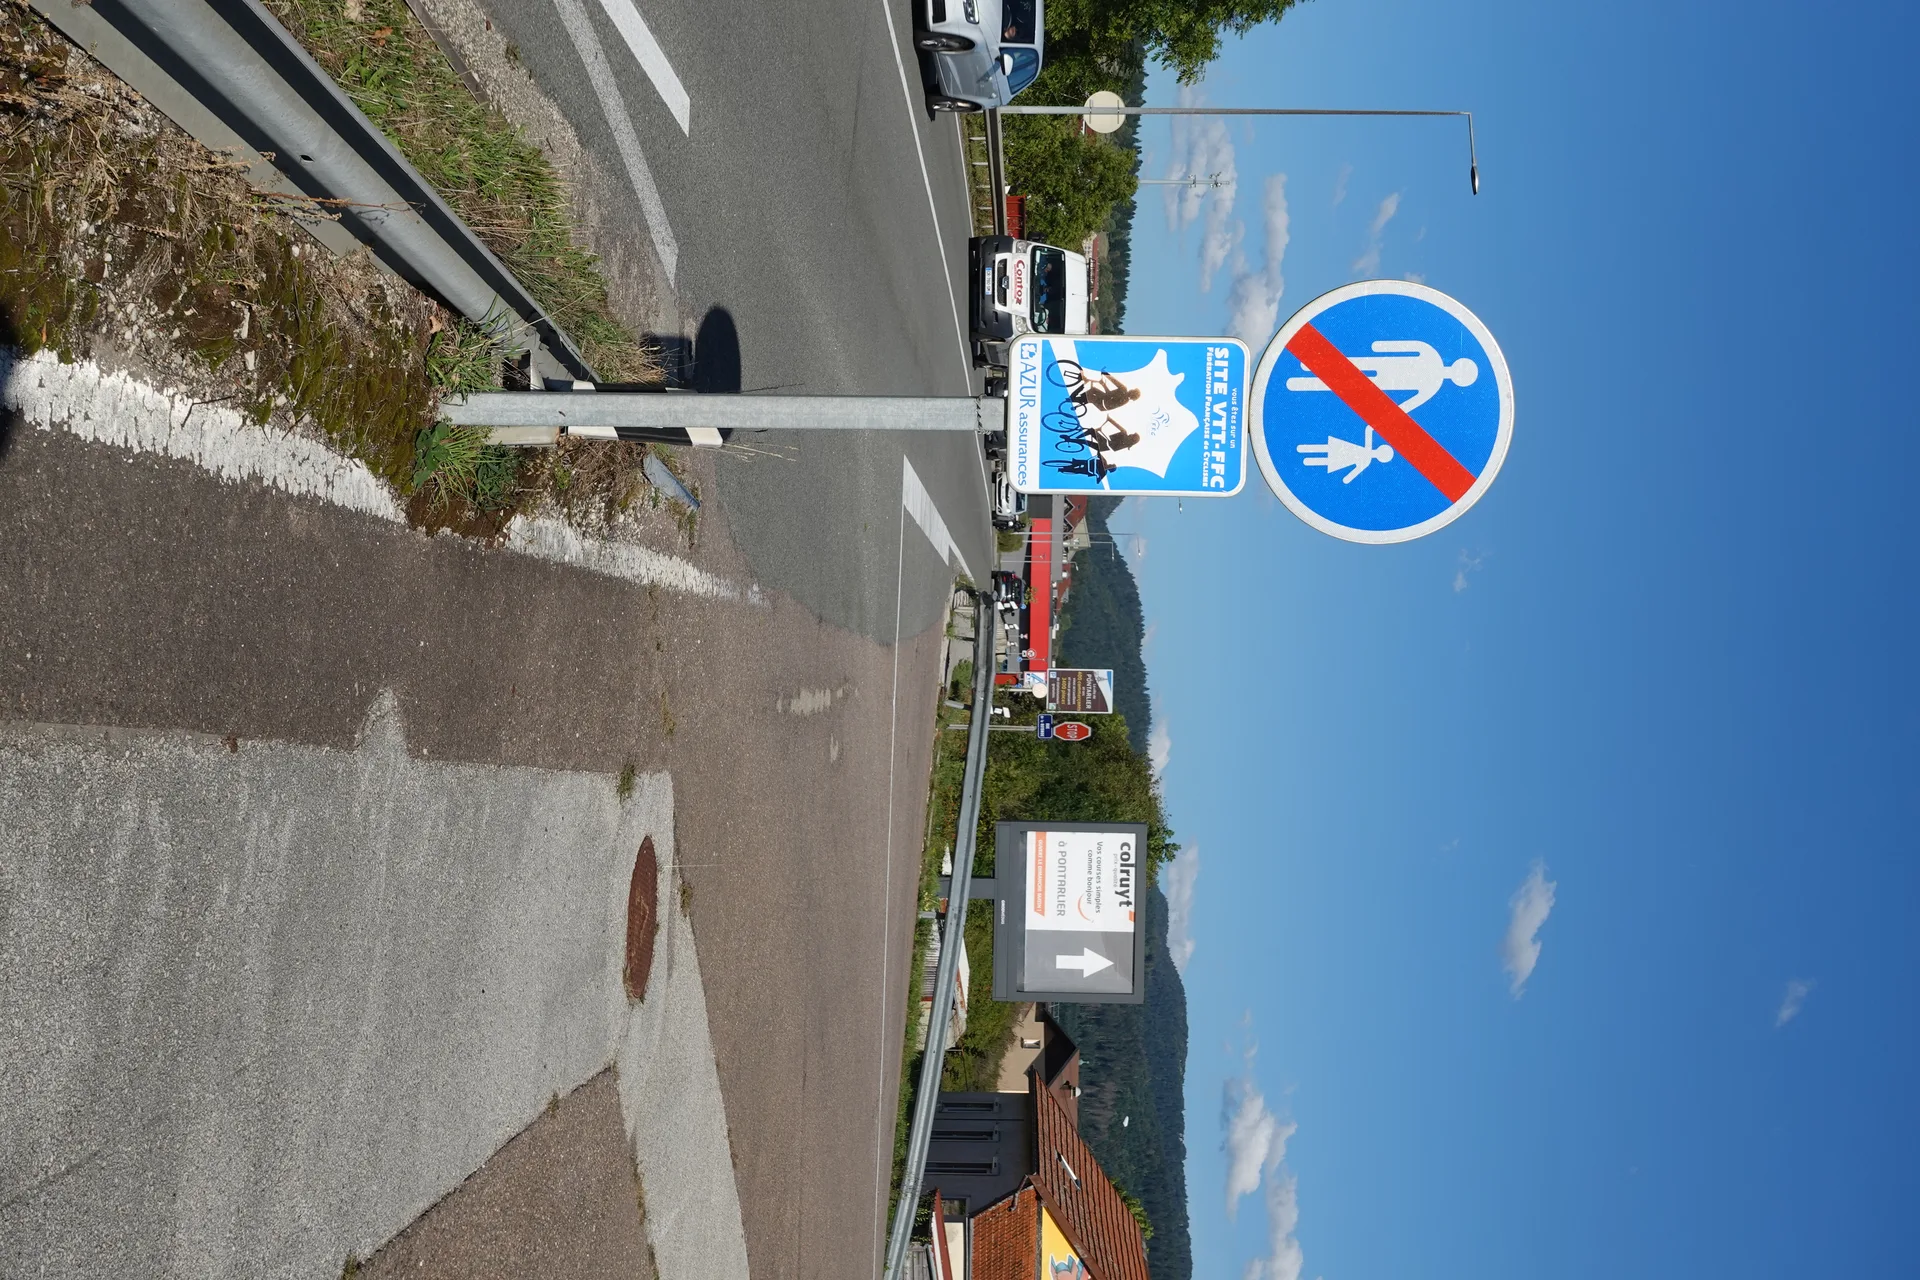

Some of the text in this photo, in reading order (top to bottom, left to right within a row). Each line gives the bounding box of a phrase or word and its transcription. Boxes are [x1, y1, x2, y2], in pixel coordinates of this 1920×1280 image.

[1018, 362, 1036, 486] AZUR assurances
[1203, 441, 1209, 450] de
[1210, 348, 1228, 488] SITE VTT-FFC
[1230, 440, 1235, 448] un
[1067, 724, 1077, 738] STOP
[1057, 851, 1066, 916] PONTARLIER
[1115, 842, 1135, 907] colruyt
